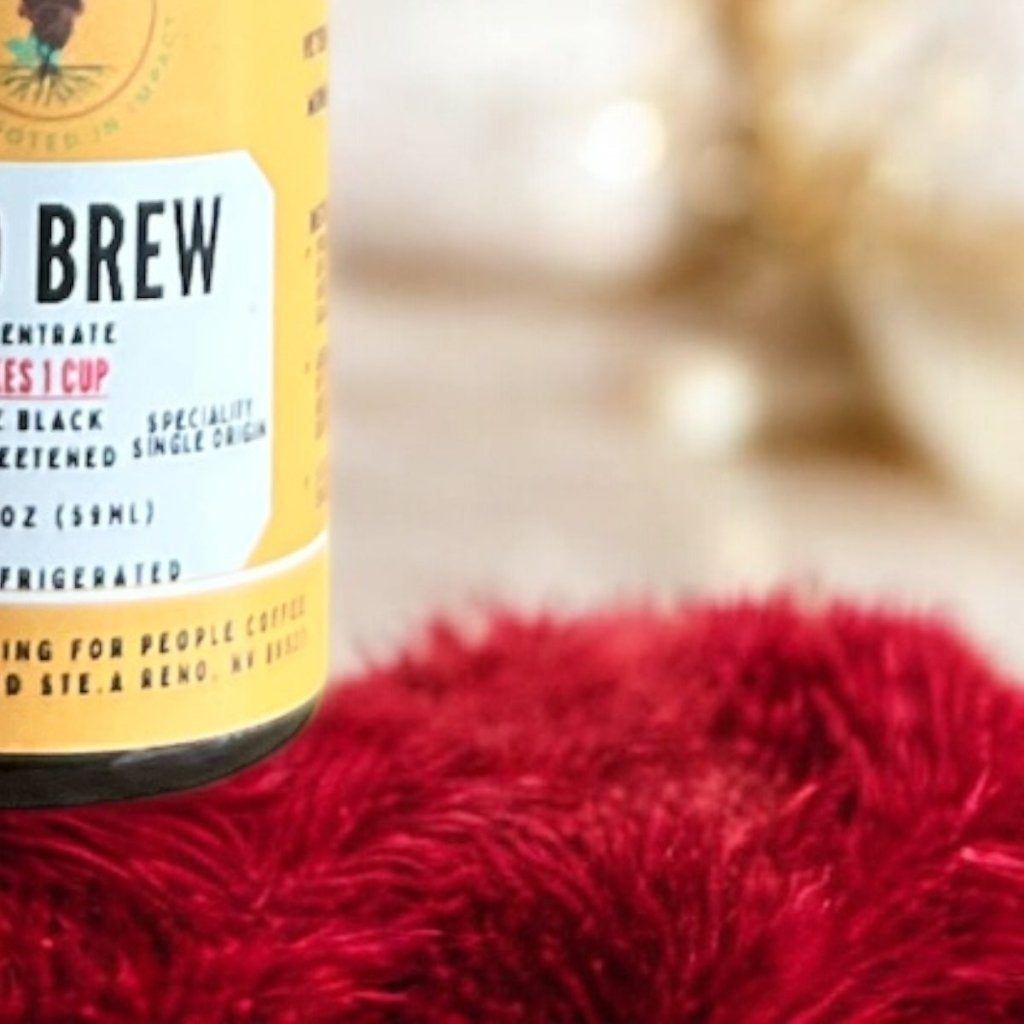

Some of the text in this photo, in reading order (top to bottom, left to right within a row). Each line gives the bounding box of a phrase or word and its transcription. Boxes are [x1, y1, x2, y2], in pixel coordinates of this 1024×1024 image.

[36, 194, 222, 304] BREW
[43, 358, 52, 394] 1
[61, 357, 110, 394] CUP
[17, 409, 103, 431] BLACK
[133, 418, 267, 460] SINGLE ORIGIN
[0, 504, 37, 528] OZ
[55, 498, 154, 531] (59ML)
[71, 636, 123, 662] FOR
[140, 619, 233, 656] PEOPLE
[245, 593, 307, 637] COFFEE
